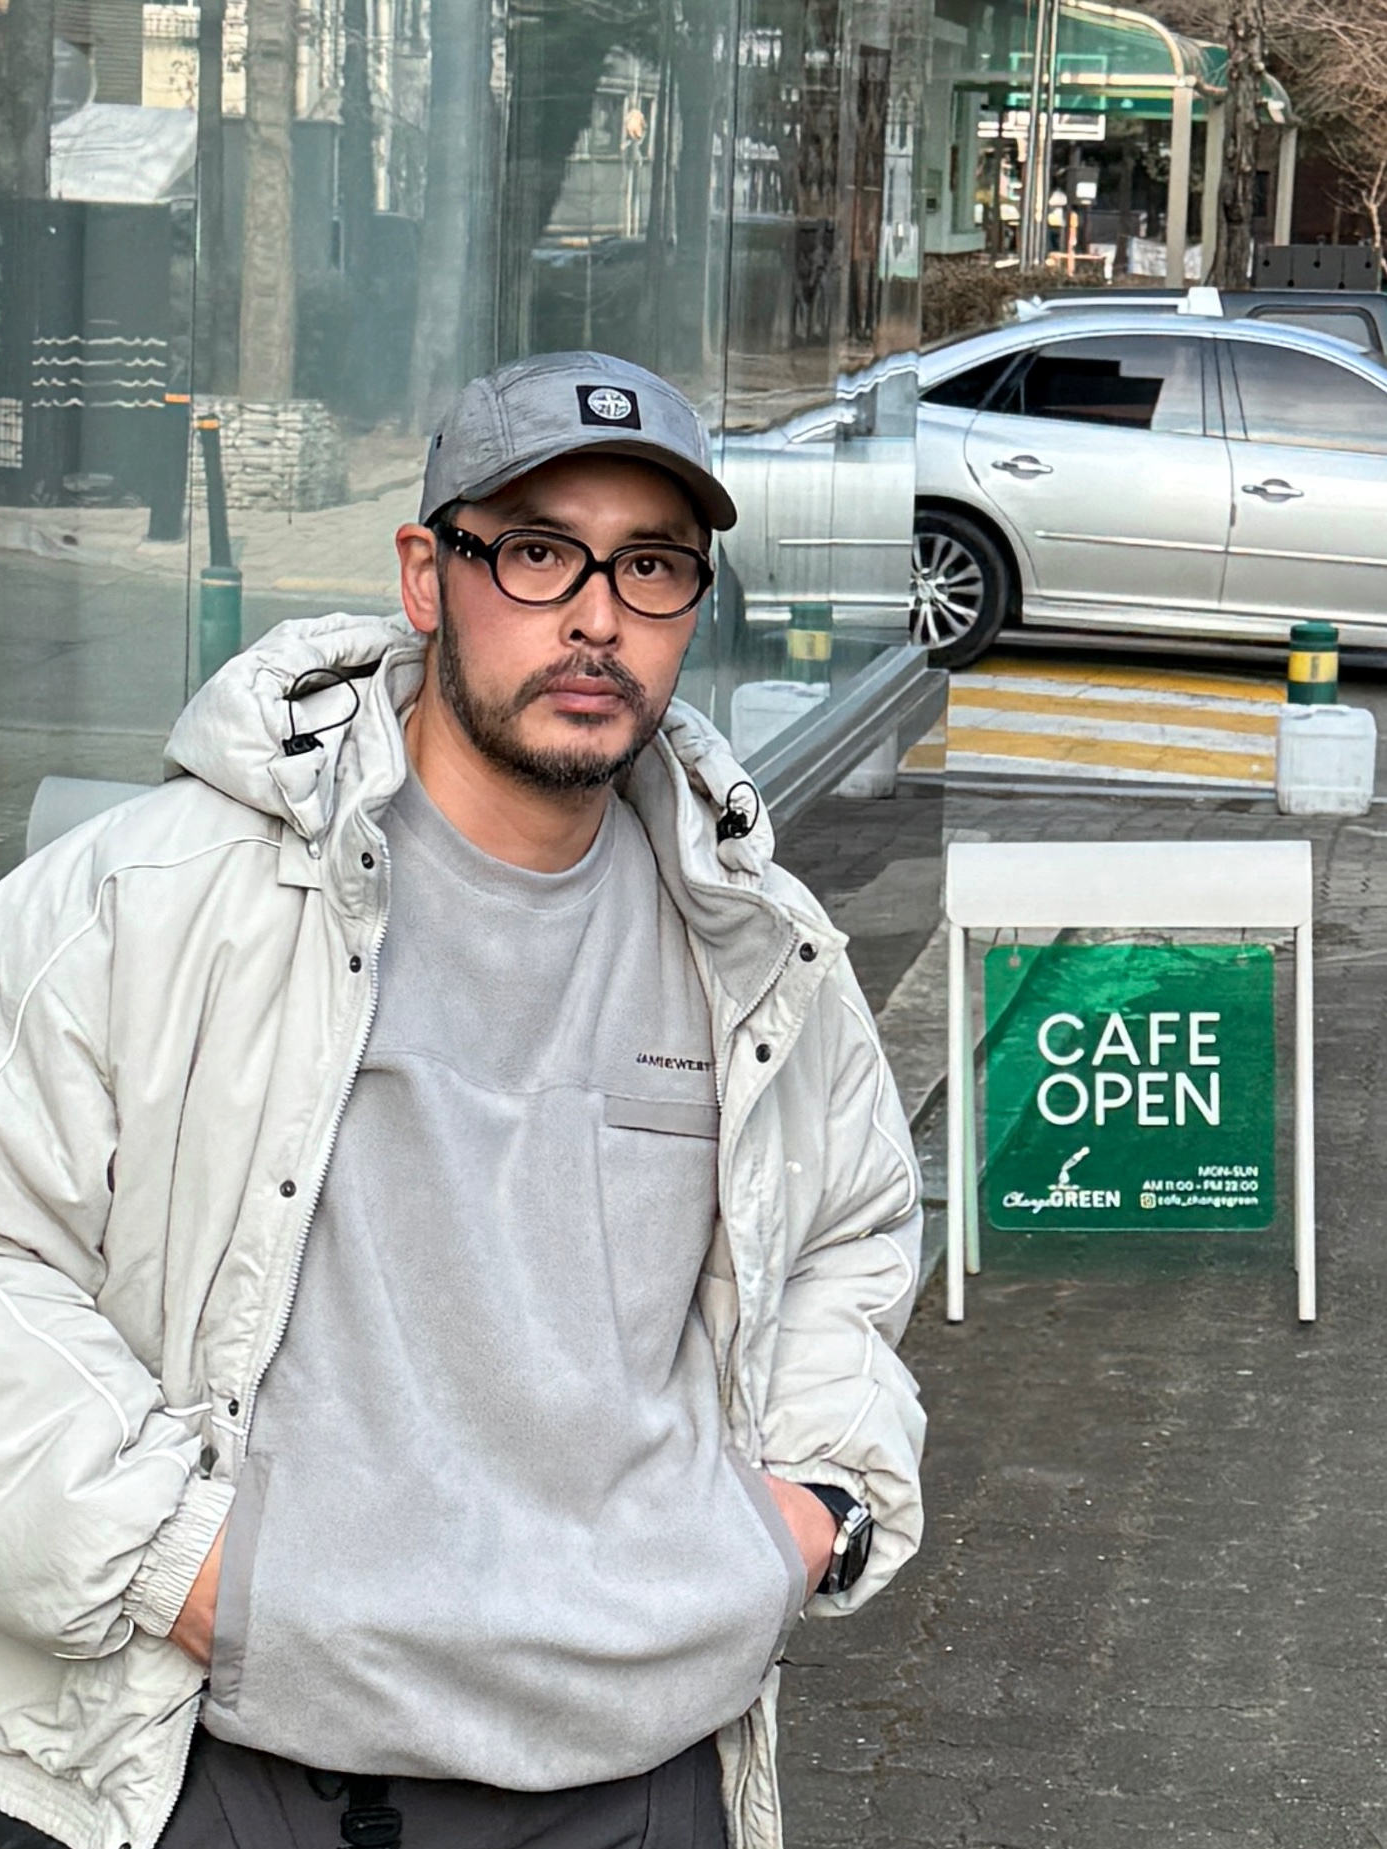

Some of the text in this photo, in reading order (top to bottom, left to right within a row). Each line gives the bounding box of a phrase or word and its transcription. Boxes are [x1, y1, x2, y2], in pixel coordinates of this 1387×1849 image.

[1037, 1011, 1220, 1066] CAFE
[1037, 1071, 1220, 1126] OPEN
[1142, 1179, 1163, 1191] AM
[1203, 1180, 1223, 1191] PM
[1198, 1165, 1259, 1178] MON-SUN
